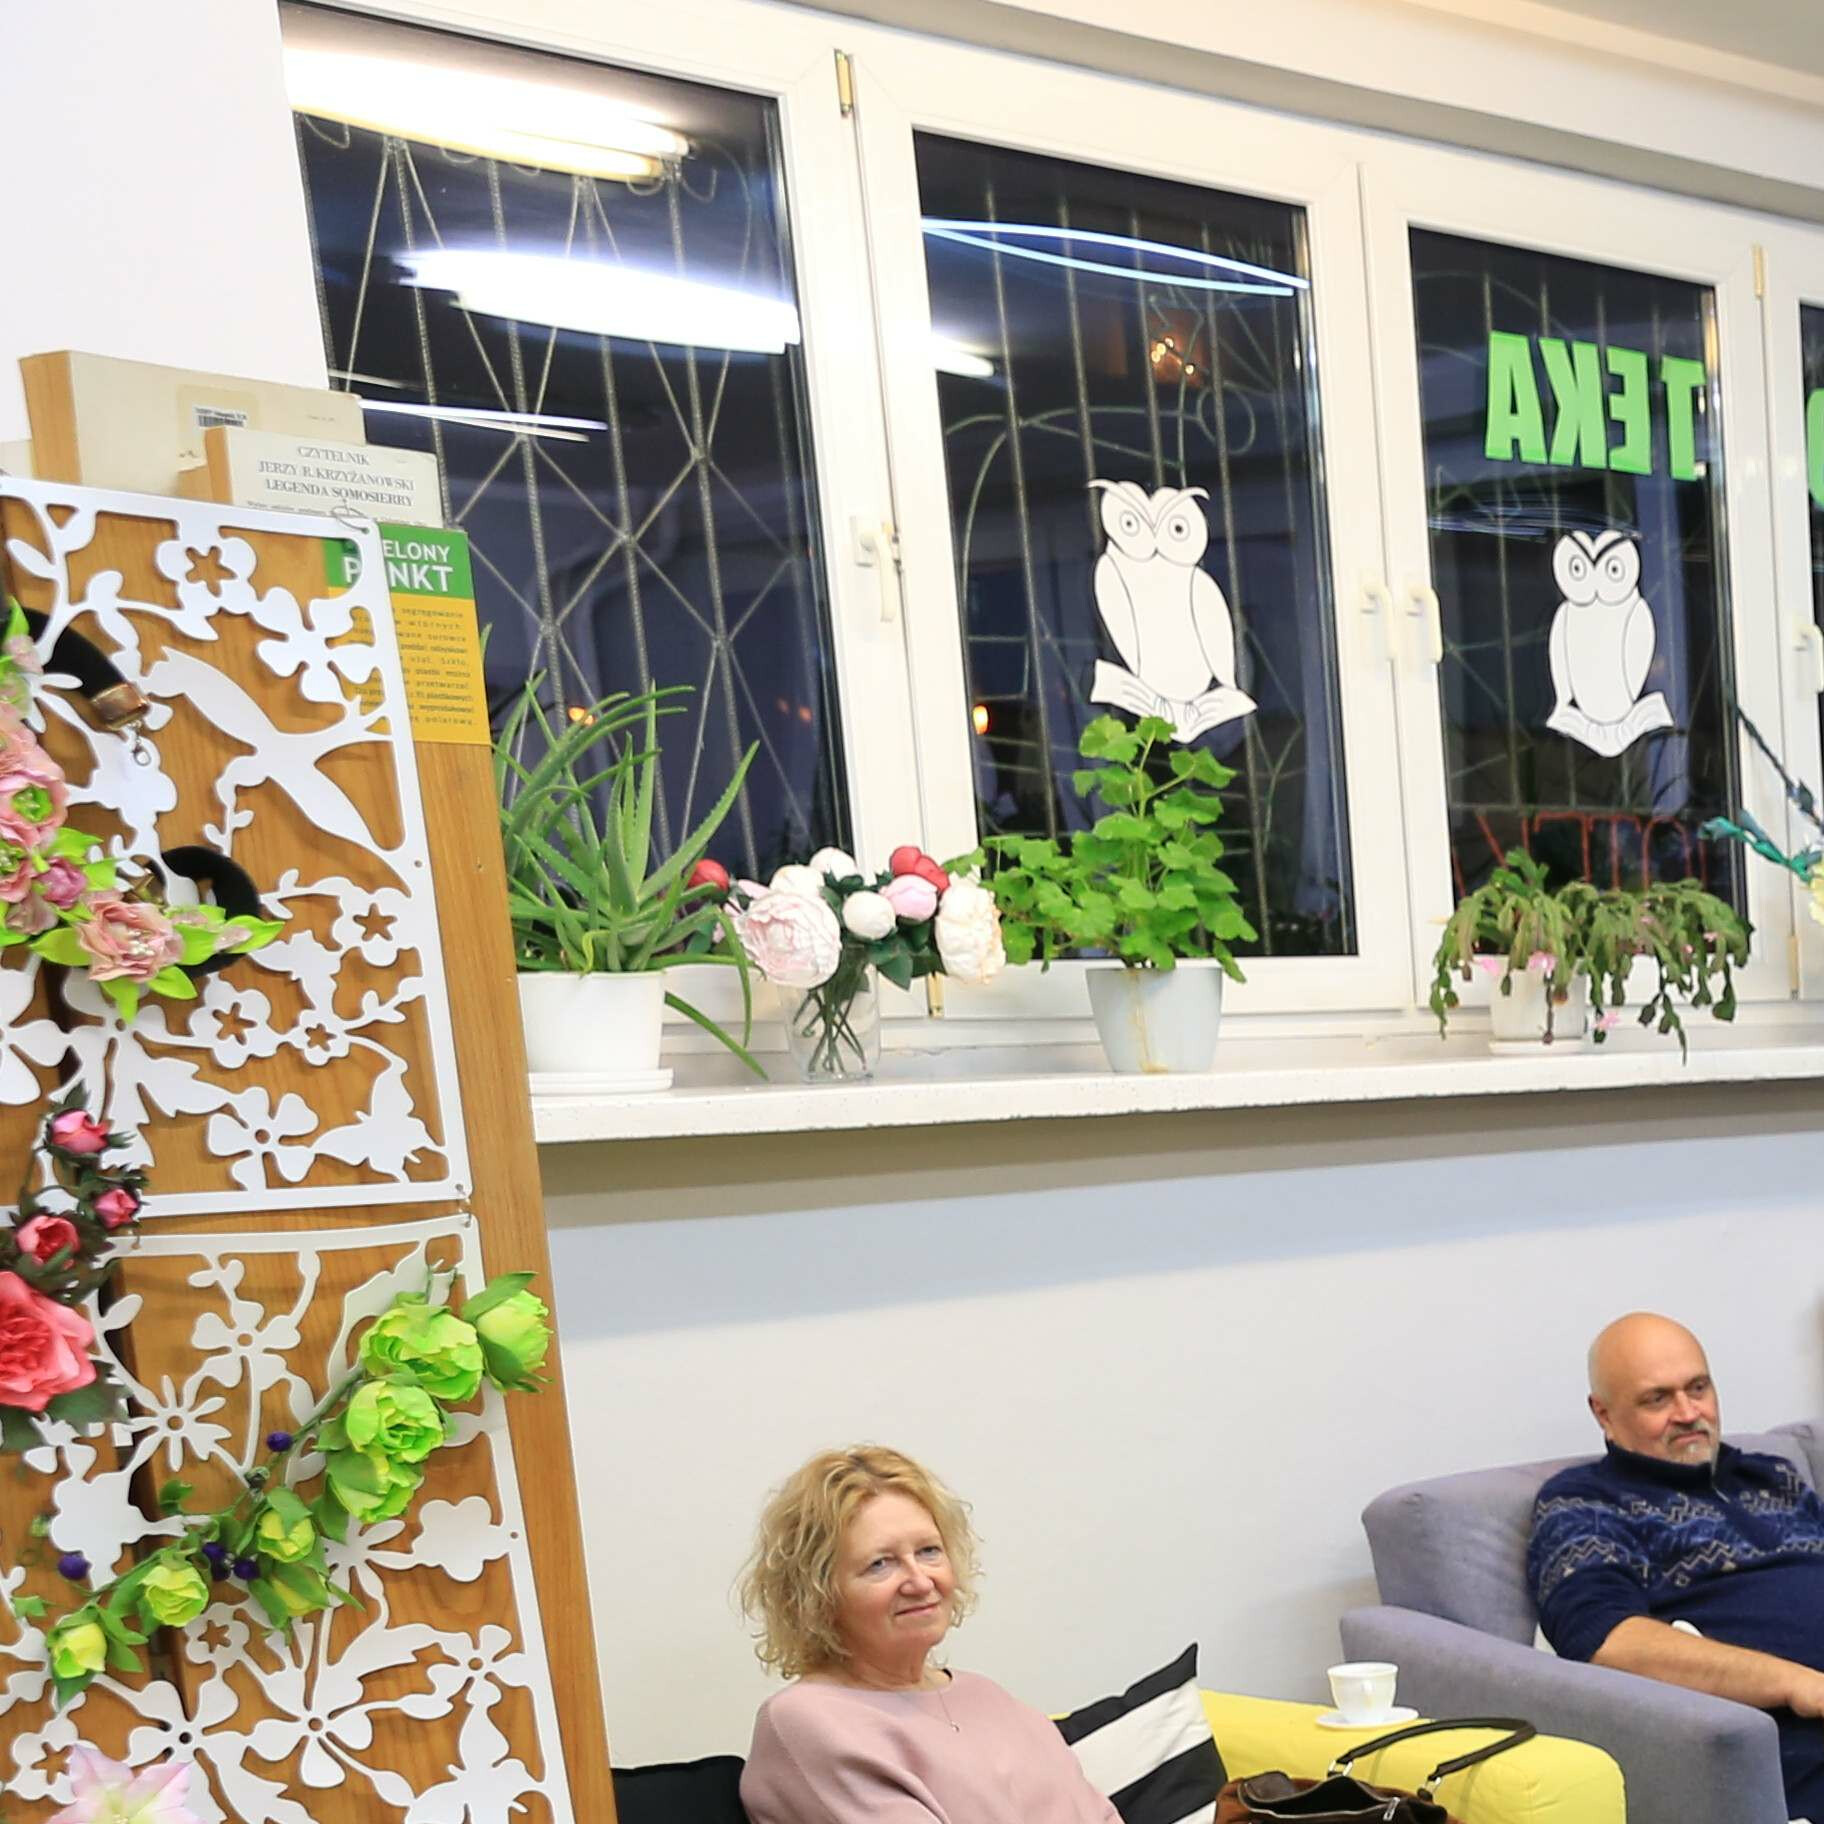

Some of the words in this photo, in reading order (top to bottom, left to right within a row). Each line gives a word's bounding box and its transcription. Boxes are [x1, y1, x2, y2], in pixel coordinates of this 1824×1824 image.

[258, 460, 298, 476] JERZY
[298, 446, 370, 467] CZYTELNIK
[265, 478, 330, 498] LEGENDA
[331, 486, 414, 508] SOMOSIERRY
[343, 556, 454, 593] PNKT
